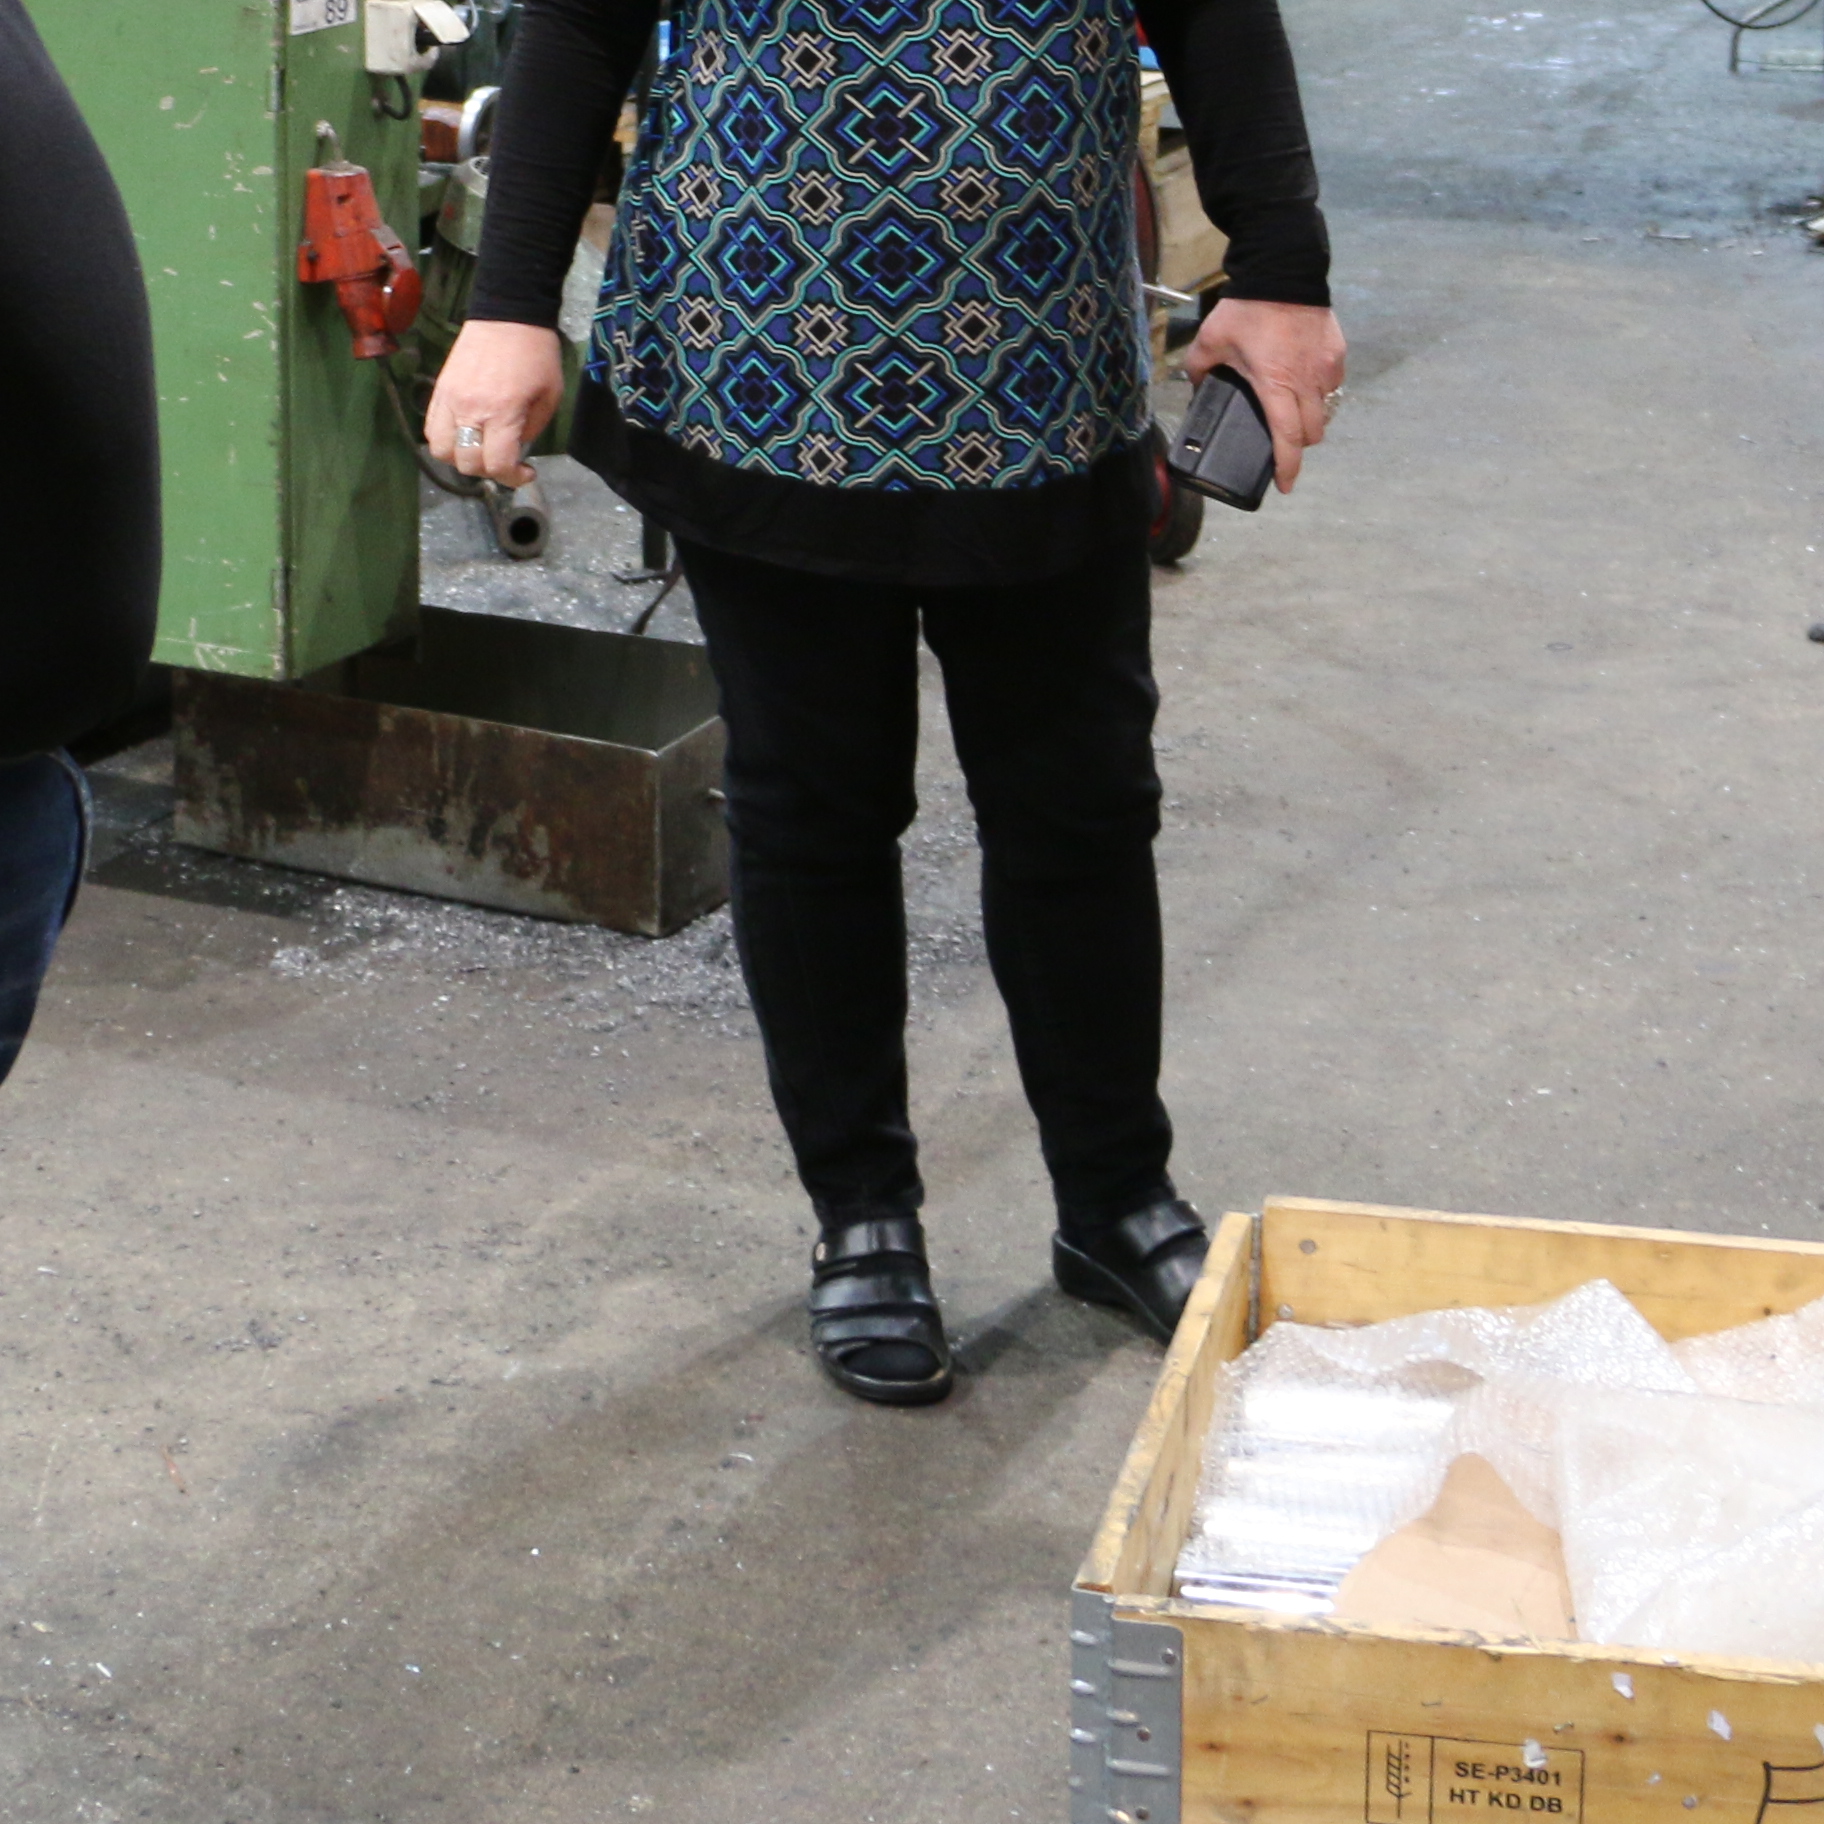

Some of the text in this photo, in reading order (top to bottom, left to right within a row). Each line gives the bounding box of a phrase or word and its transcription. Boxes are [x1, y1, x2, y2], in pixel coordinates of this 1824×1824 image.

[1453, 1760, 1563, 1787] SE-P3401
[1449, 1787, 1564, 1814] HT KD DB
